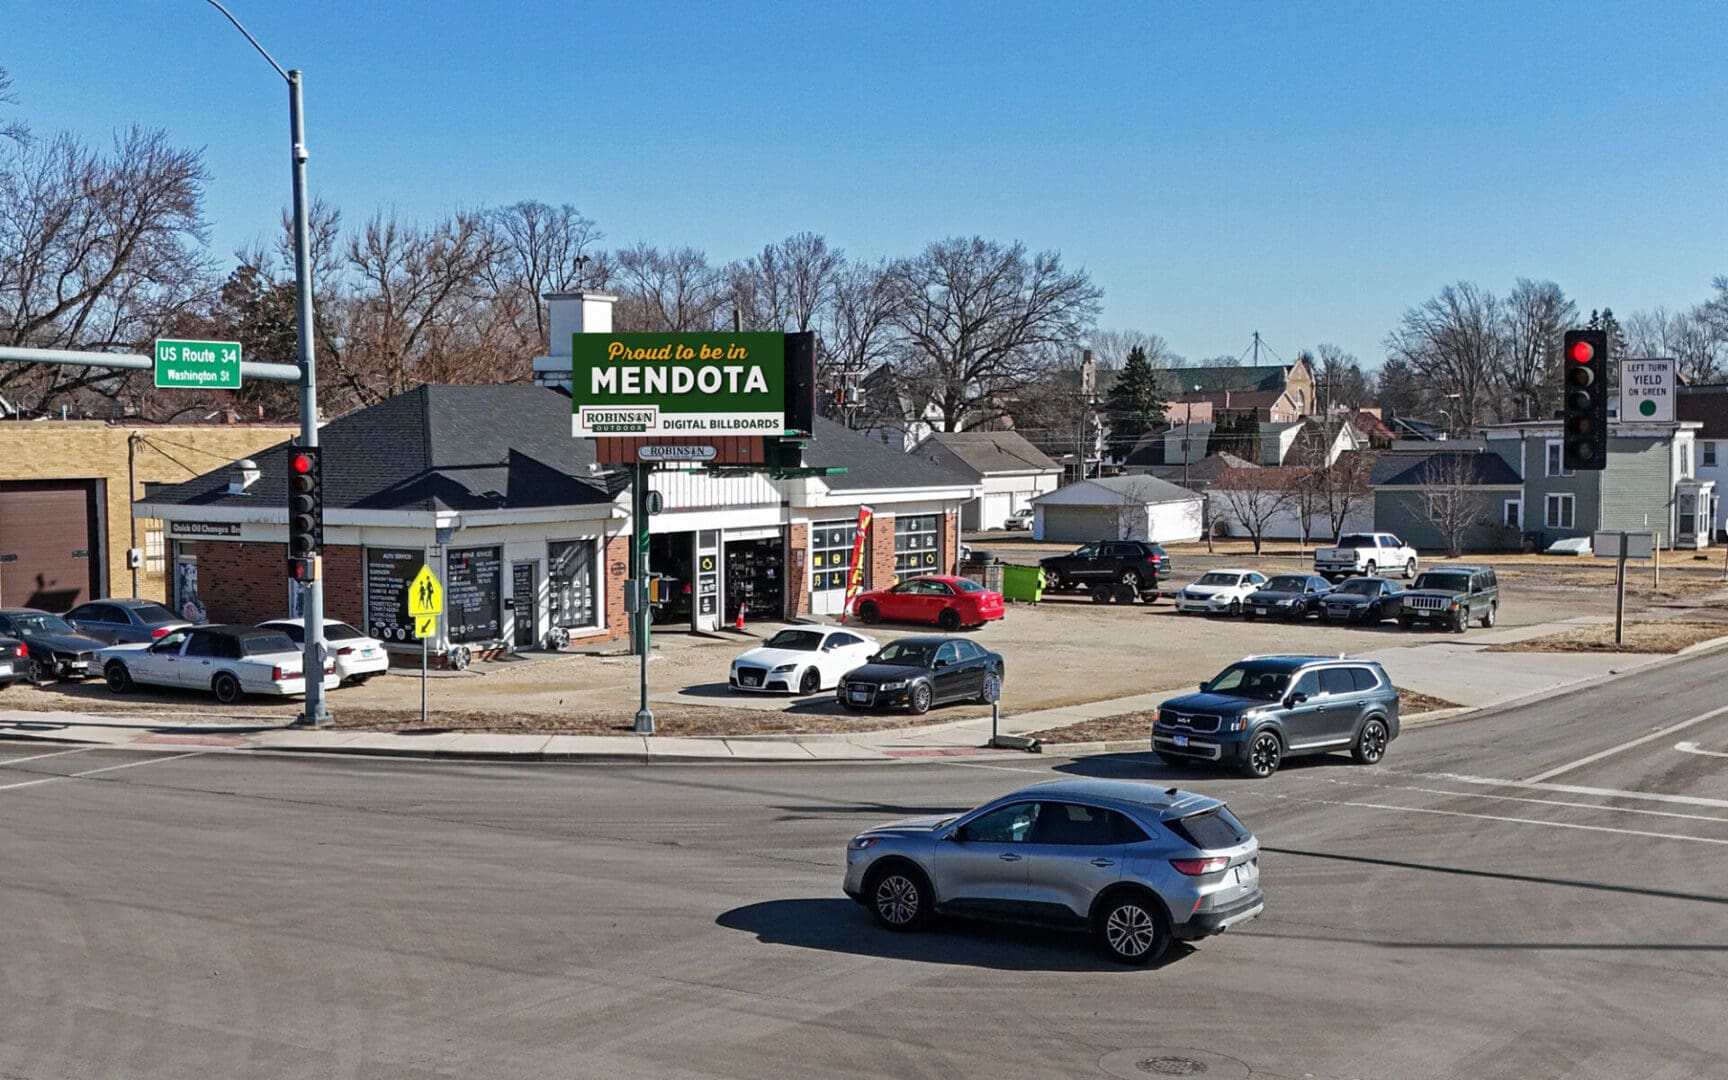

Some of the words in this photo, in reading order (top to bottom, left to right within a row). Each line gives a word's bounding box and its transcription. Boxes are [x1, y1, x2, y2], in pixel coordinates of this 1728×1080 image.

[160, 347, 177, 361] US
[182, 347, 215, 362] Route
[221, 349, 237, 363] 34
[608, 341, 672, 361] Proud
[675, 344, 696, 360] to
[699, 344, 724, 360] be
[727, 343, 748, 360] in
[1628, 364, 1645, 372] LEFT
[167, 369, 217, 384] Washington
[220, 371, 230, 382] St
[591, 365, 769, 394] MENDOTA
[1633, 374, 1662, 385] YIELD
[1628, 388, 1639, 396] ON
[1642, 388, 1666, 396] GREEN
[662, 419, 706, 430] DIGITAL
[709, 419, 779, 430] BILLBOARDS
[173, 523, 191, 533] Quick
[191, 523, 201, 533] Oil
[201, 524, 229, 535] Changes
